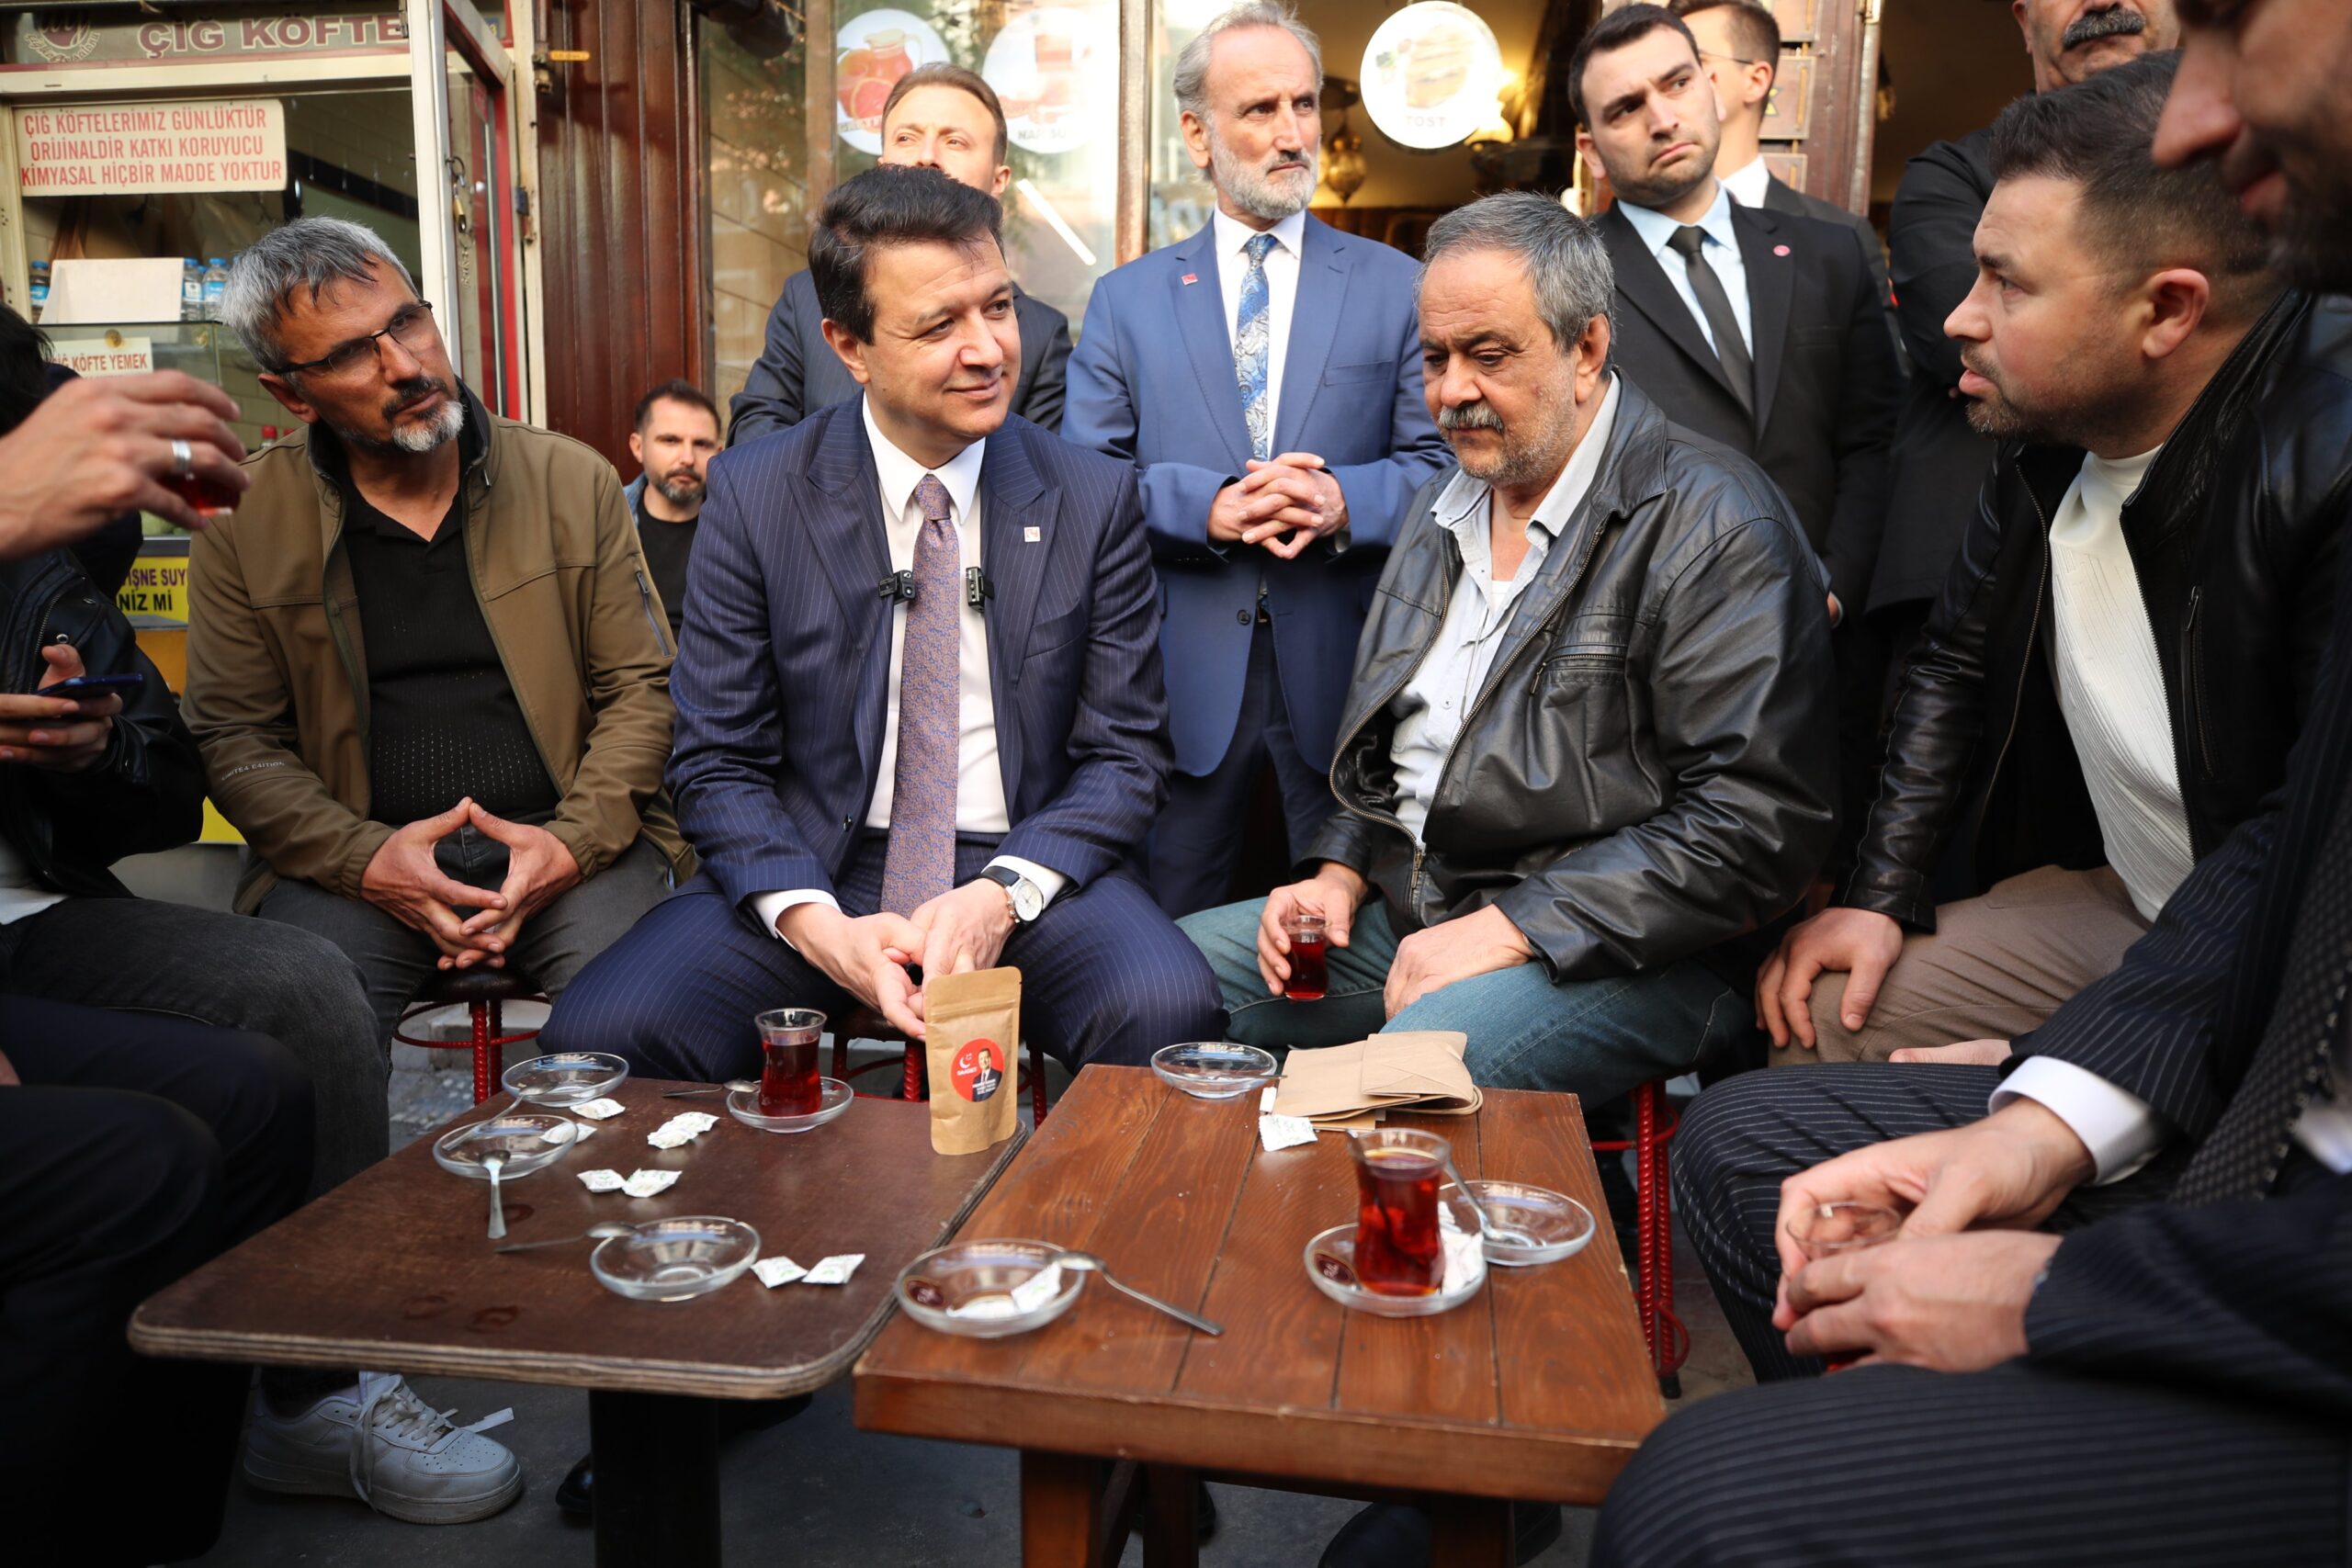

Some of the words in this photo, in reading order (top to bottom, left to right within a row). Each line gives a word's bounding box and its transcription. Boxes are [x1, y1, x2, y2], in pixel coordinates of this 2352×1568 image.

[240, 13, 408, 51] KÖFTE
[25, 110, 51, 137] ÇİĞ
[55, 107, 166, 134] KÖFTELERİMİZ
[172, 105, 266, 130] GÜNLÜKTÜR
[1405, 115, 1447, 127] TOST
[30, 136, 124, 162] ORİJİNALDİR
[130, 138, 173, 158] KATKI
[179, 135, 264, 157] KORUYUCU
[21, 164, 96, 186] KİMYASAL
[102, 161, 154, 187] HİÇBİR
[161, 163, 216, 183] MADDE
[220, 161, 282, 182] YOKTUR
[73, 353, 107, 371] KÖFTE
[109, 353, 148, 370] YEMEK
[153, 589, 173, 611] Mİ
